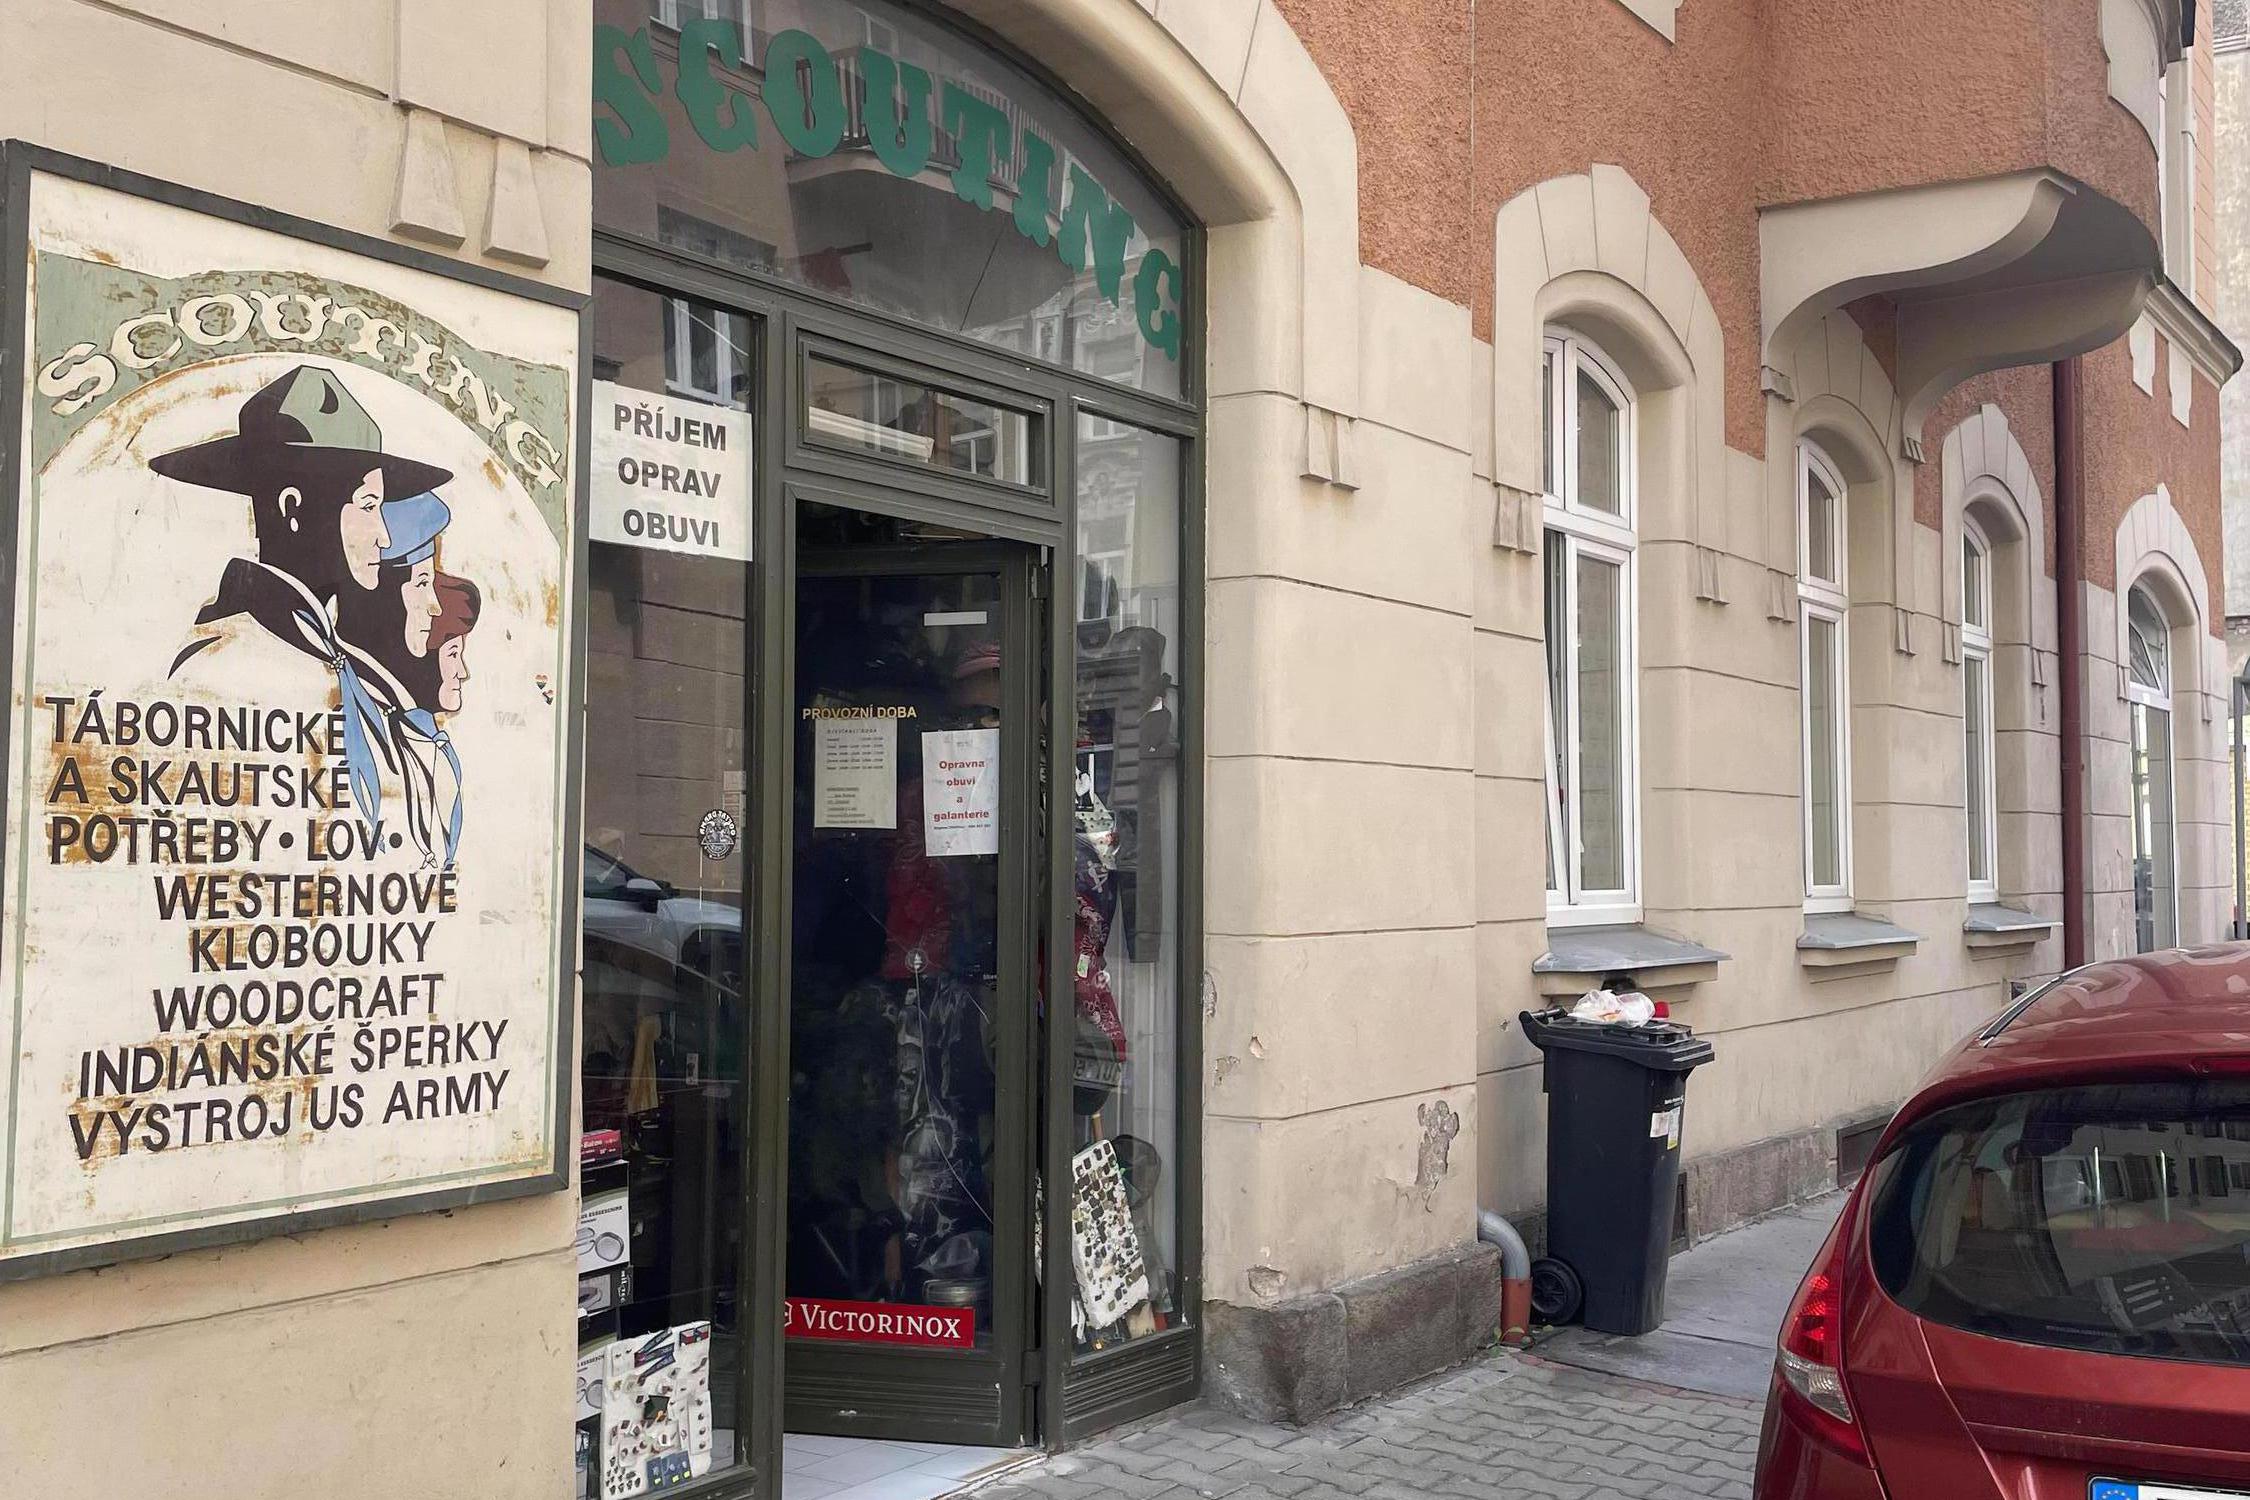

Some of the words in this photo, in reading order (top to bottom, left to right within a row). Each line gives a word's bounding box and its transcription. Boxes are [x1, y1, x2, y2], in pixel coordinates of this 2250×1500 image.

[593, 18, 1181, 361] SCOUTING
[38, 293, 562, 489] SCOUTING
[614, 402, 726, 451] PŘÍJEM
[618, 457, 721, 498] OPRAV
[623, 509, 720, 548] OBUVI
[45, 690, 347, 756] TÁBORNICKÉ
[803, 704, 873, 720] PROVOZNÍ
[877, 706, 917, 718] DOBA
[49, 757, 89, 804] A
[108, 756, 350, 809] SKAUTSKÉ
[939, 760, 985, 771] Opravna
[946, 778, 976, 786] obuvi
[50, 810, 271, 864] POTŘEBY
[307, 819, 384, 862] LOV
[933, 810, 990, 822] galanterie
[154, 863, 457, 921] WESTERNOVÉ
[192, 922, 435, 973] KLOBOUKY
[153, 973, 444, 1032] WOODCRAFT
[80, 1025, 335, 1098] INDIÁNSKÉ
[350, 1019, 508, 1073] ŠPERKY
[68, 1090, 293, 1160] VÝSTROJ
[309, 1083, 364, 1131] US
[382, 1069, 510, 1124] ARMY
